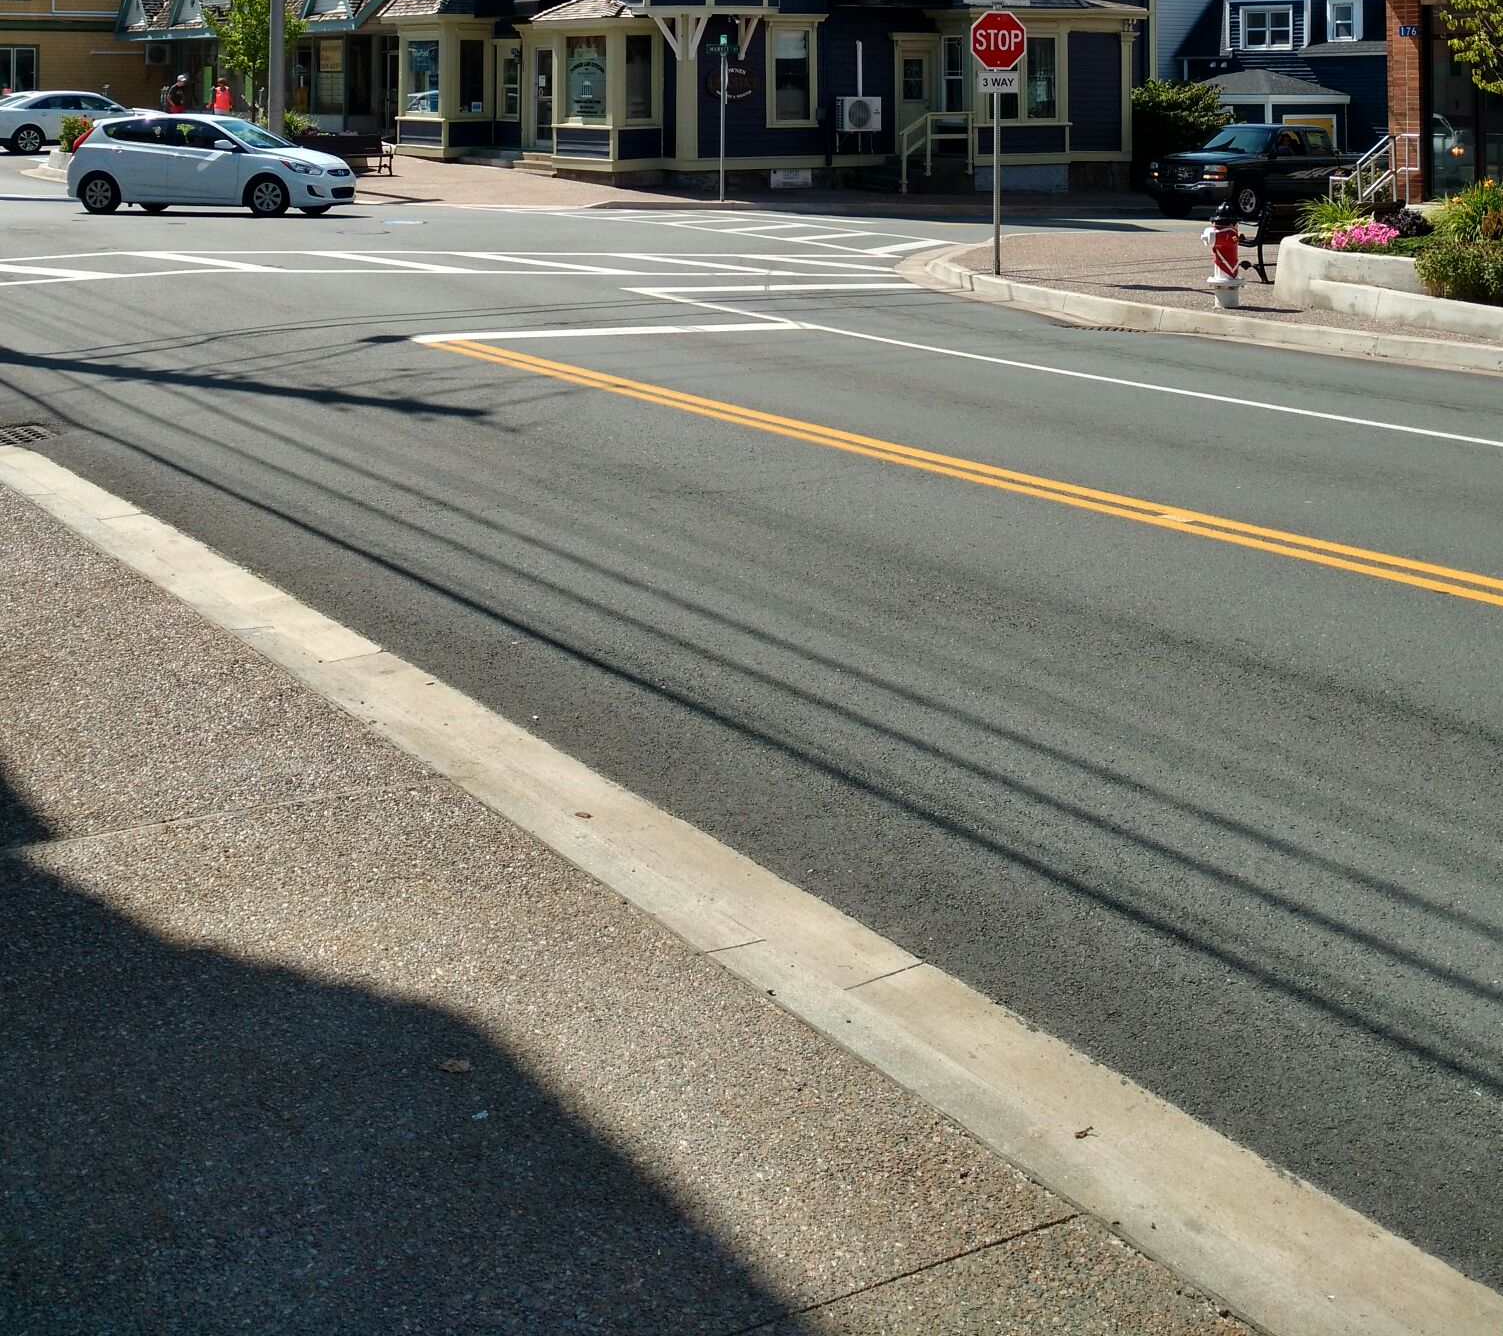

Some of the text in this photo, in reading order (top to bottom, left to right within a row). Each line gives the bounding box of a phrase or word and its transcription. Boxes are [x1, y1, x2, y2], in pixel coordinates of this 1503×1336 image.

[1401, 26, 1416, 36] 176
[975, 29, 1023, 51] STOP
[982, 77, 1015, 87] 3 WAY
